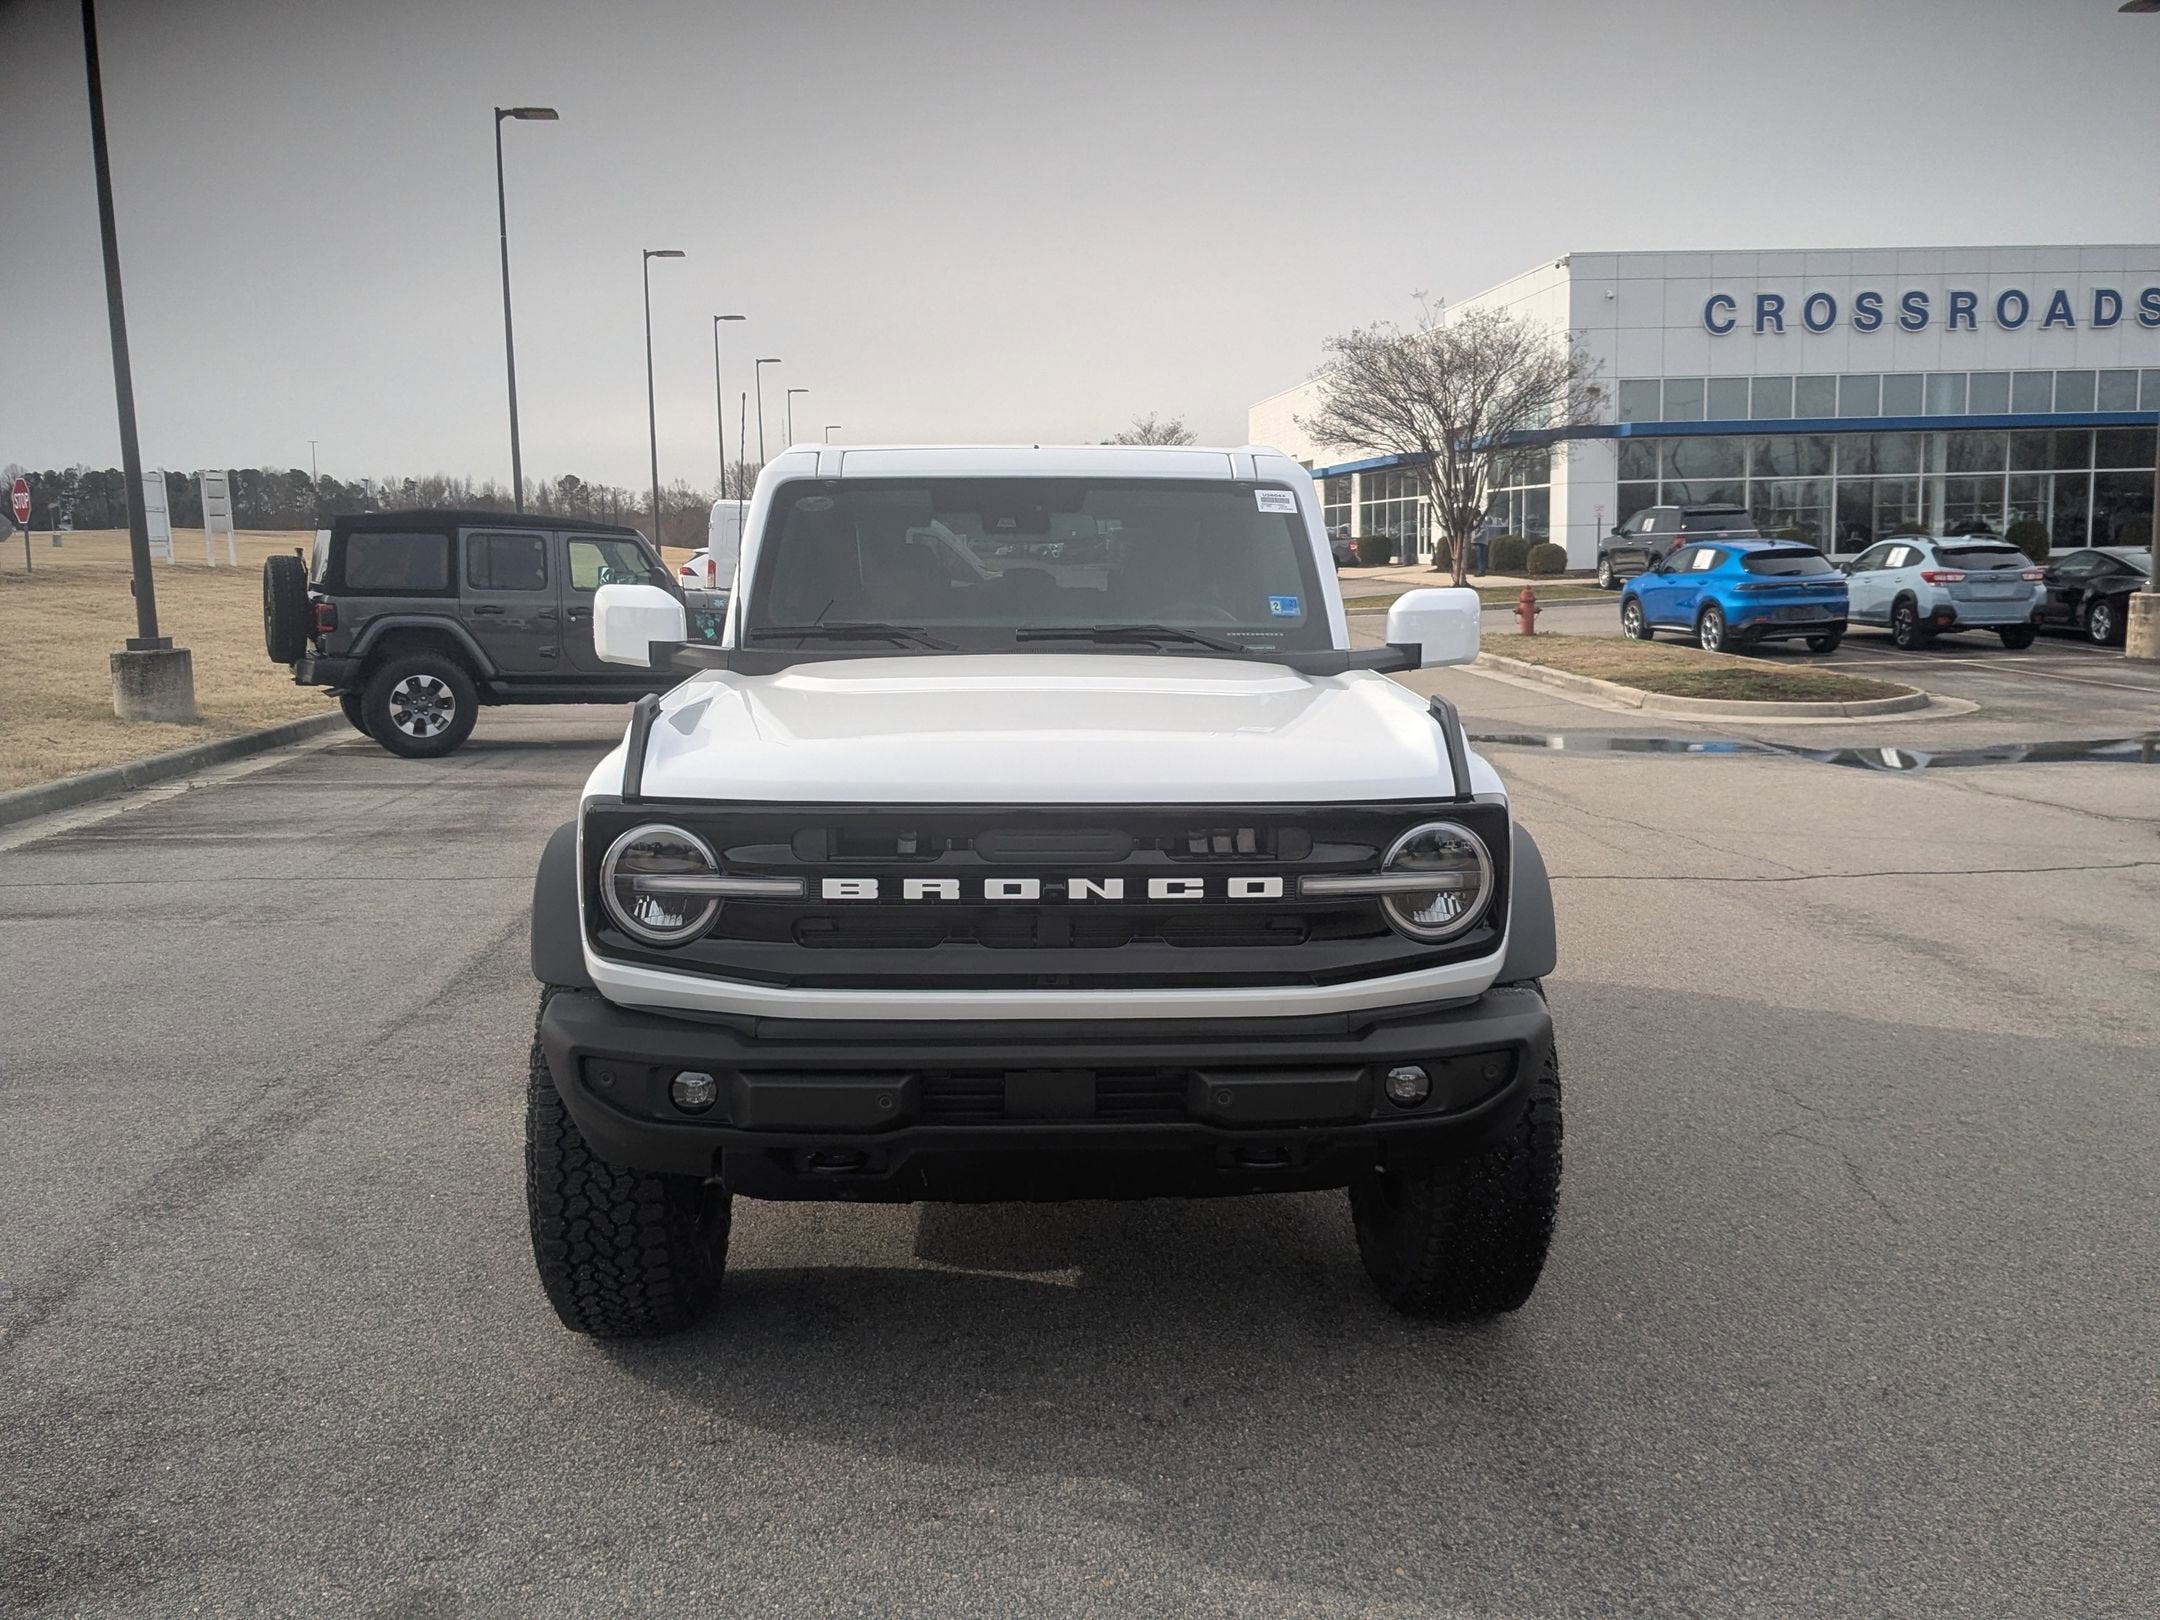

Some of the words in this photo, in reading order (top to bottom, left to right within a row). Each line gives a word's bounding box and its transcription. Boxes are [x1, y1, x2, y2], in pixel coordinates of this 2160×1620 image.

[1703, 287, 2160, 335] CROSSROADS
[14, 492, 29, 509] STOP
[821, 877, 1284, 901] BRONCO
